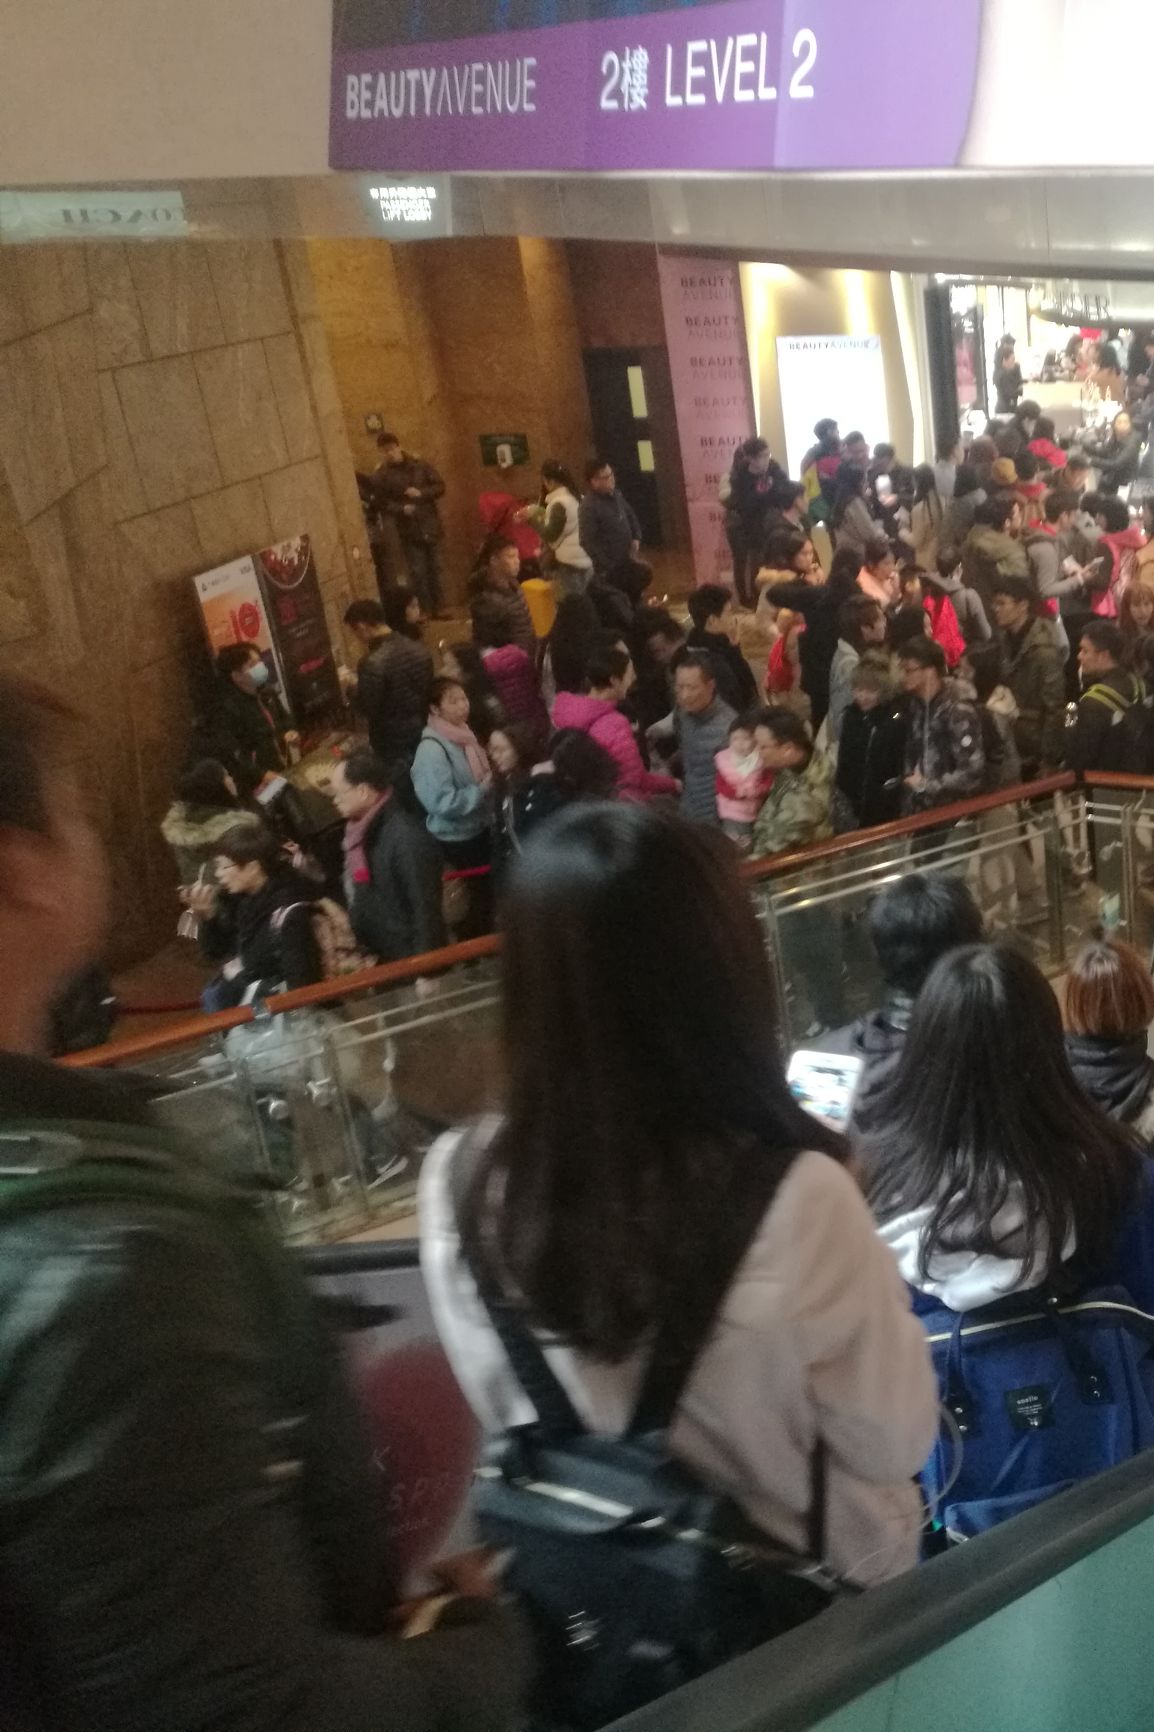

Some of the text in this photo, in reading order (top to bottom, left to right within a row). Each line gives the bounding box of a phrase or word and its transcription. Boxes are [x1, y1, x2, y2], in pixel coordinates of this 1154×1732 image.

[665, 31, 777, 107] LEVEL
[789, 28, 817, 98] 2
[700, 435, 742, 448] BEAUT
